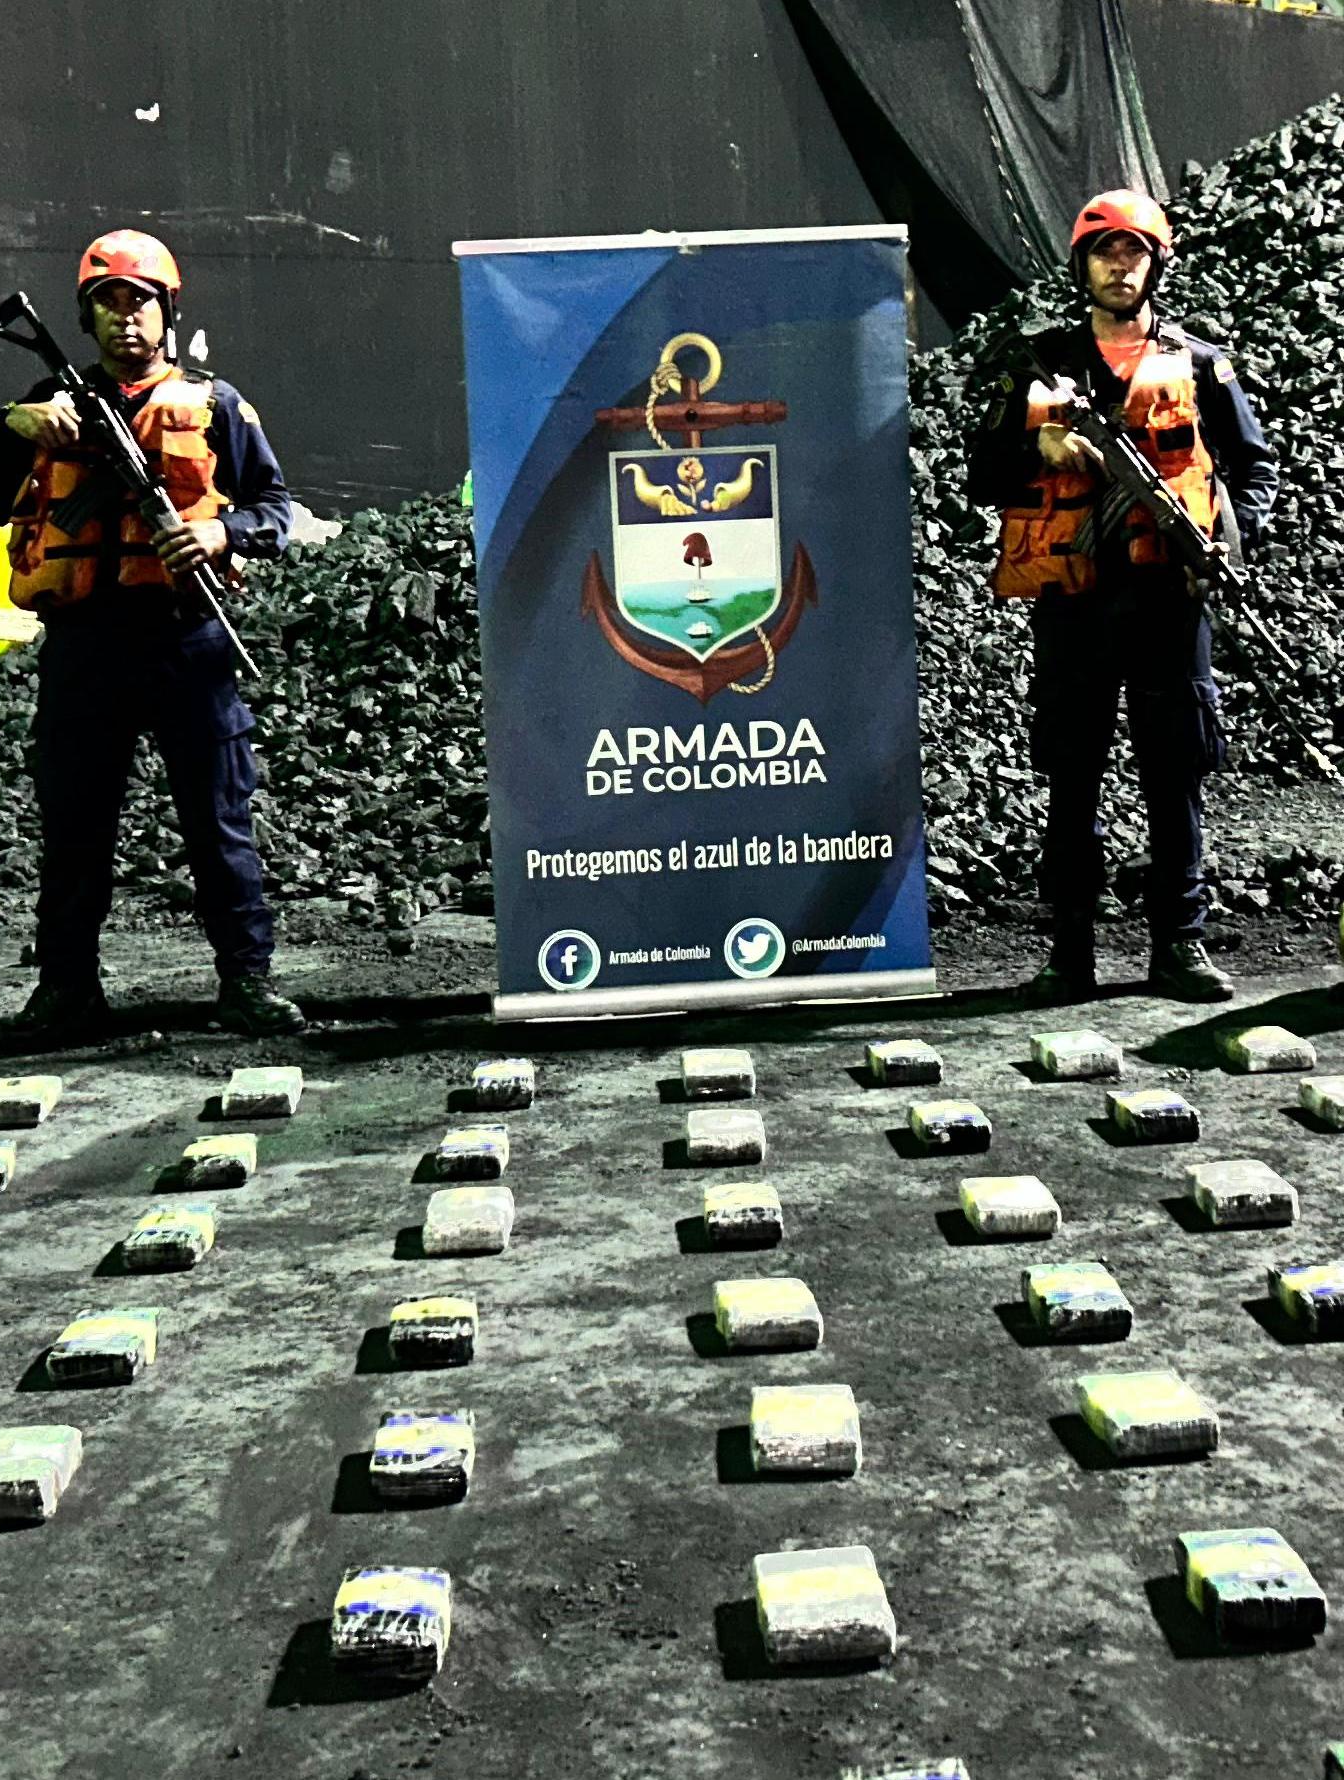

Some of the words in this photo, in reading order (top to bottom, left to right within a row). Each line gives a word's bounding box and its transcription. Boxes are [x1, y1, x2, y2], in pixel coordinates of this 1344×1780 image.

[586, 718, 826, 768] ARMADA
[586, 769, 634, 796] DE
[642, 758, 828, 793] COLOMBIA
[527, 848, 663, 881] Protegemos
[668, 839, 688, 871] el
[694, 836, 739, 869] azul
[745, 835, 772, 867] de
[777, 834, 797, 864] la
[803, 830, 893, 863] bandera
[609, 948, 649, 965] Armada
[651, 947, 664, 962] de
[665, 944, 711, 962] Colombia
[792, 933, 886, 955] @ArmadaColombia
